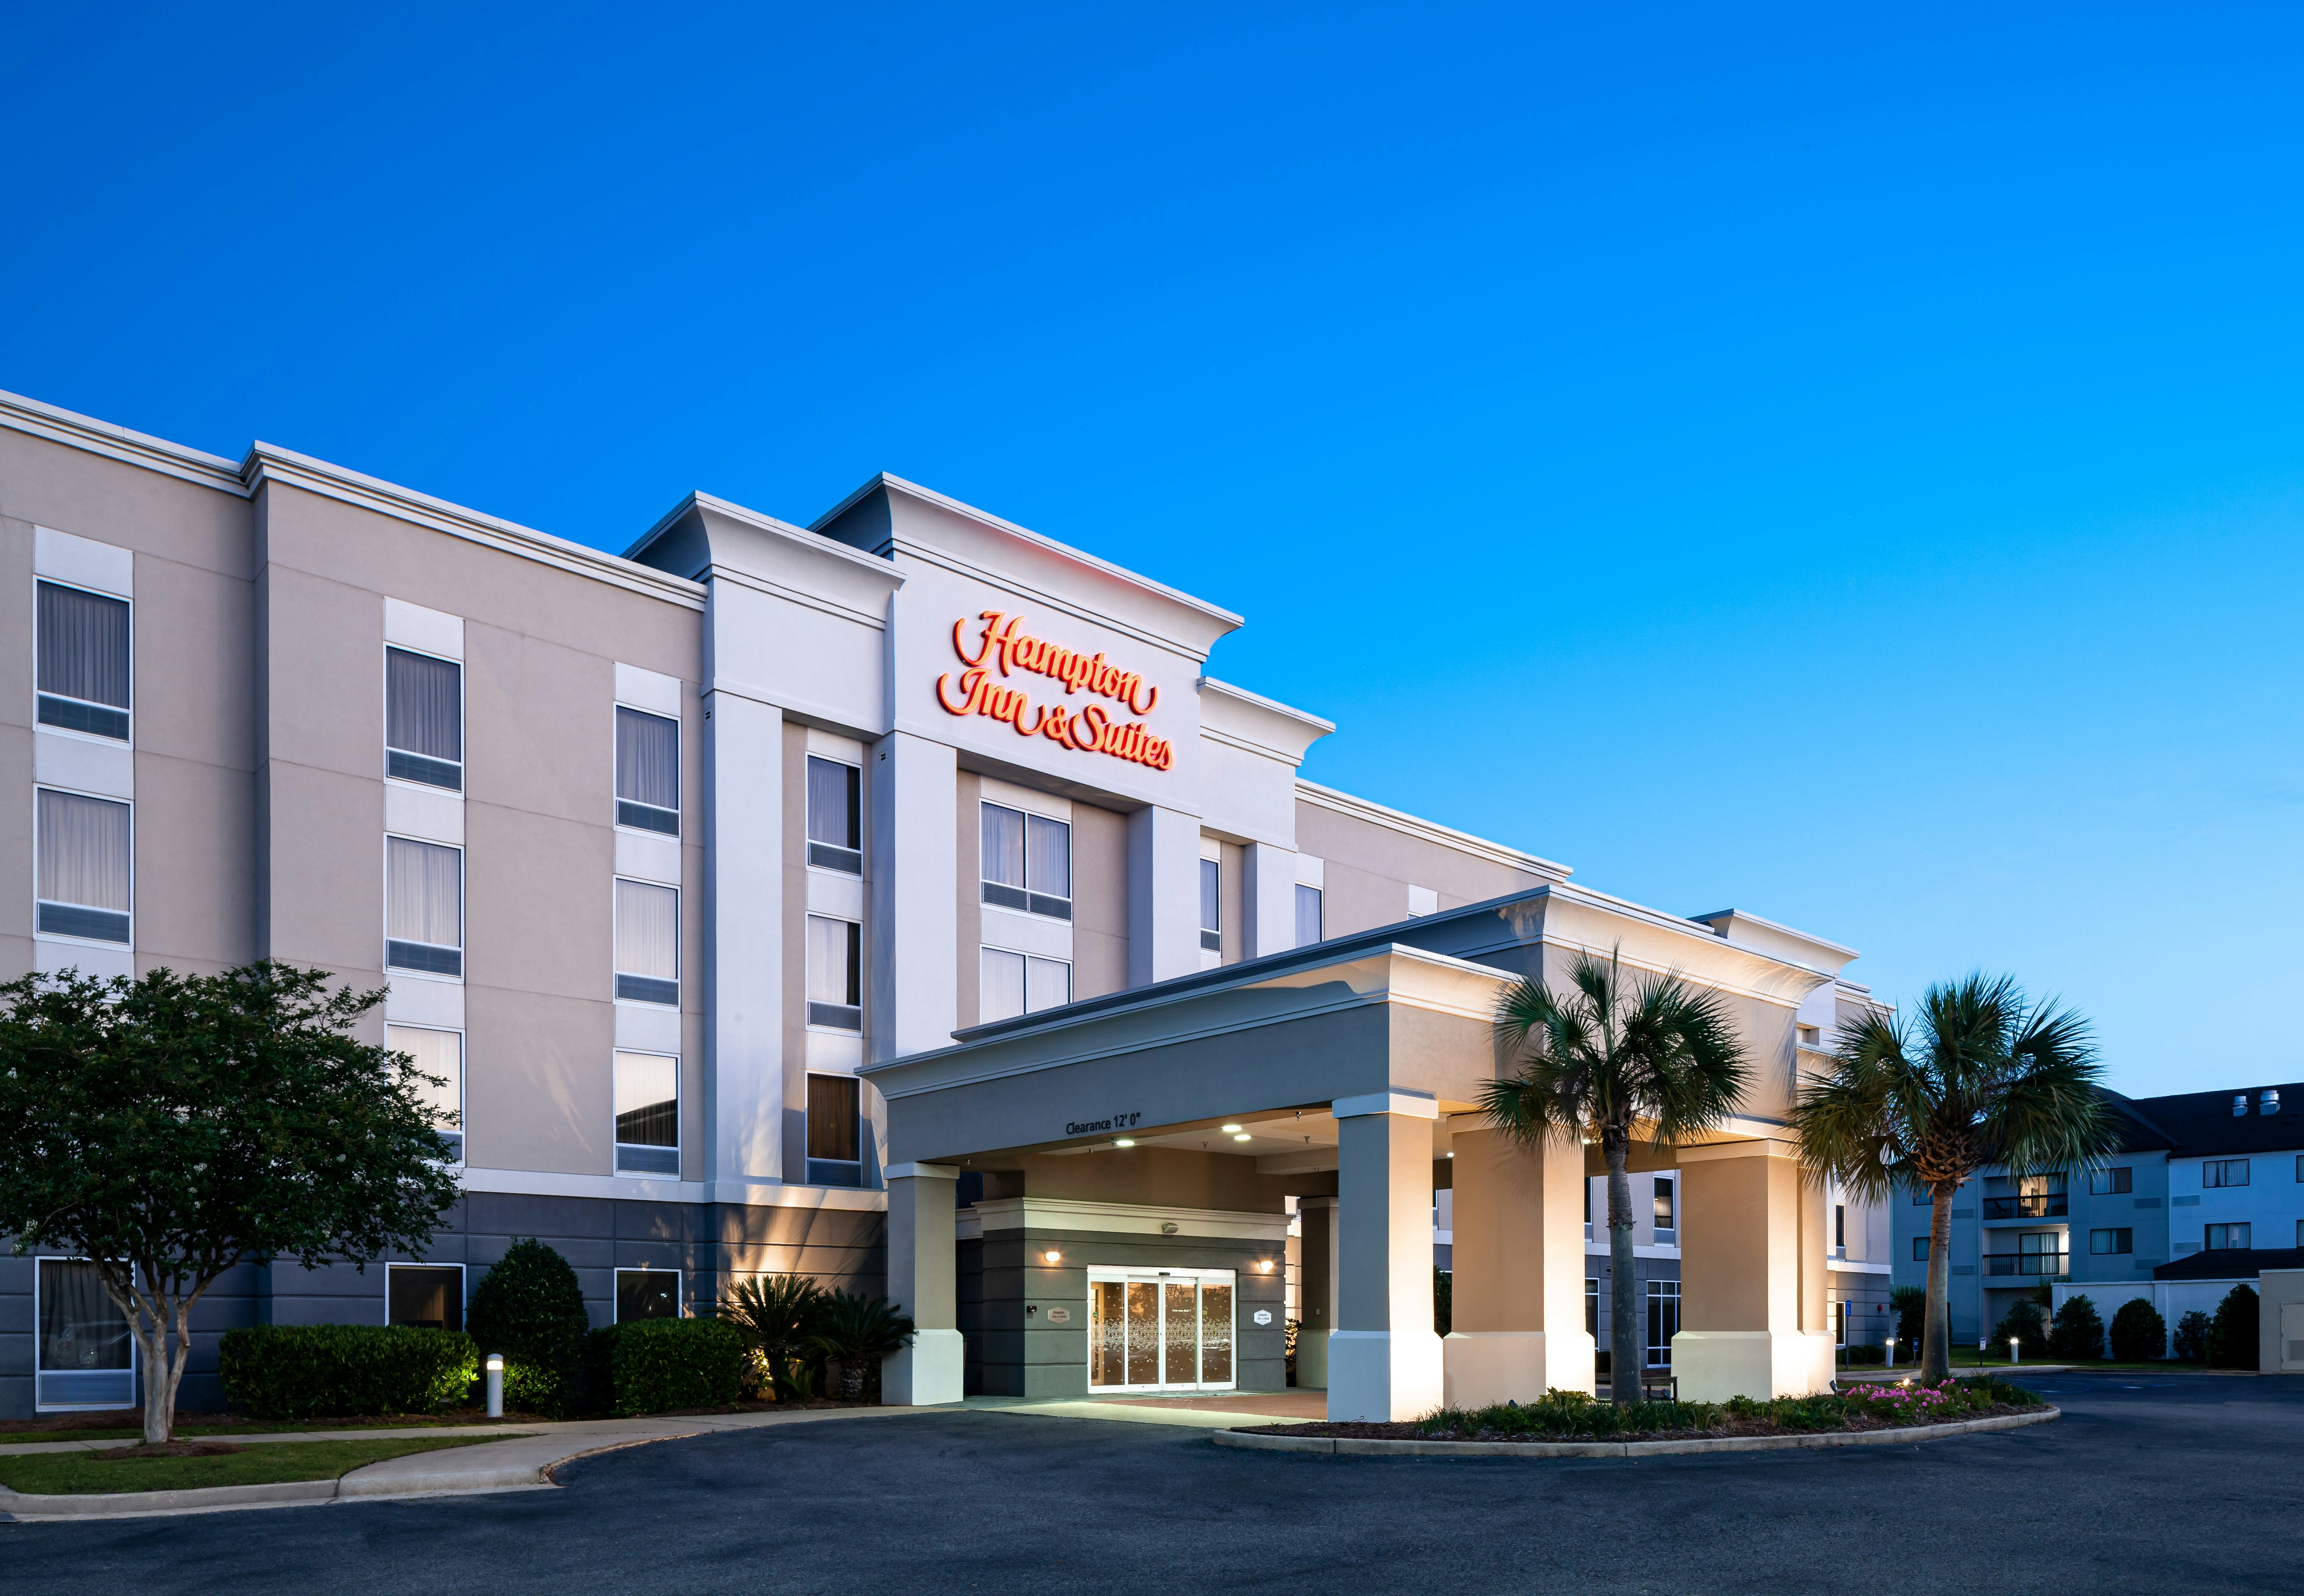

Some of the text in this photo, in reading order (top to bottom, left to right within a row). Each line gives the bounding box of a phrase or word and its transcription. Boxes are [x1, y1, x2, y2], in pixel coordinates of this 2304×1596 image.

[953, 611, 1159, 715] Hampton
[936, 668, 1174, 771] Inn & Suites
[1066, 1119, 1111, 1135] Clearance
[1114, 1114, 1127, 1127] 12'
